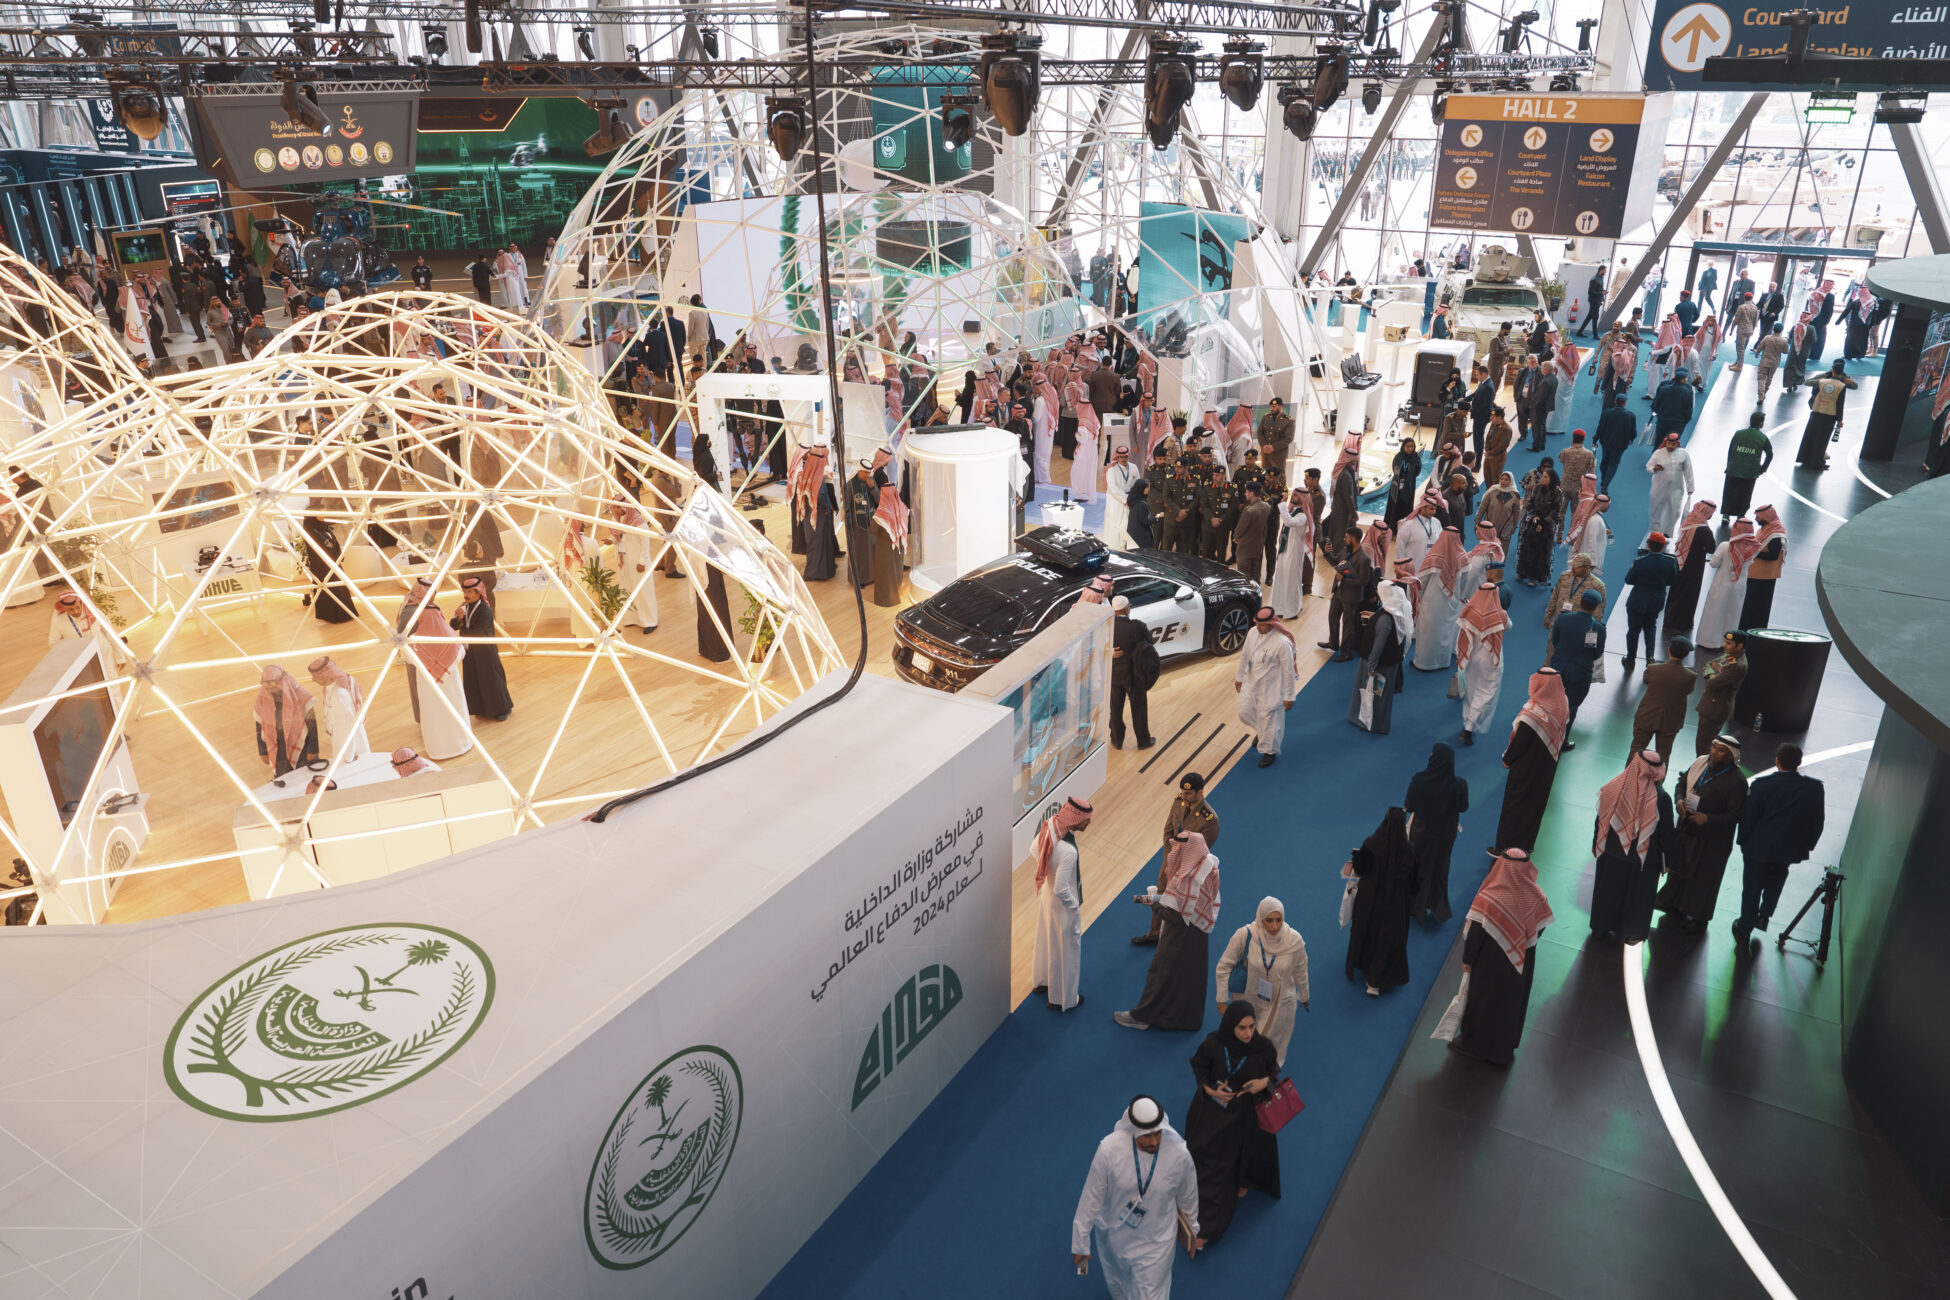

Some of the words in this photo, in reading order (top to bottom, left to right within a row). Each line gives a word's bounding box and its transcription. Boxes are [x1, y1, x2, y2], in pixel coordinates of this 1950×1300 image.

[1743, 6, 1850, 26] Couard
[1891, 7, 1948, 23] الفناء
[1503, 99, 1557, 119] HALL
[1563, 100, 1578, 119] 2
[1518, 152, 1547, 161] Courtyard
[1579, 154, 1594, 163] Land
[1594, 155, 1617, 165] Display
[1577, 180, 1611, 188] Restaurant
[1585, 172, 1606, 180] Falcon
[1736, 445, 1756, 455] MEDIA
[1008, 558, 1063, 581] POLICE
[1218, 594, 1224, 602] 11
[945, 668, 958, 679] 911
[936, 806, 983, 856] مشاركة
[963, 831, 983, 867] في
[903, 848, 934, 883] وزارة
[920, 855, 962, 902] معرض
[844, 869, 901, 932] الداخلية
[876, 886, 918, 944] الدفاع
[913, 896, 946, 936] 2024
[811, 926, 874, 1003] العالمي
